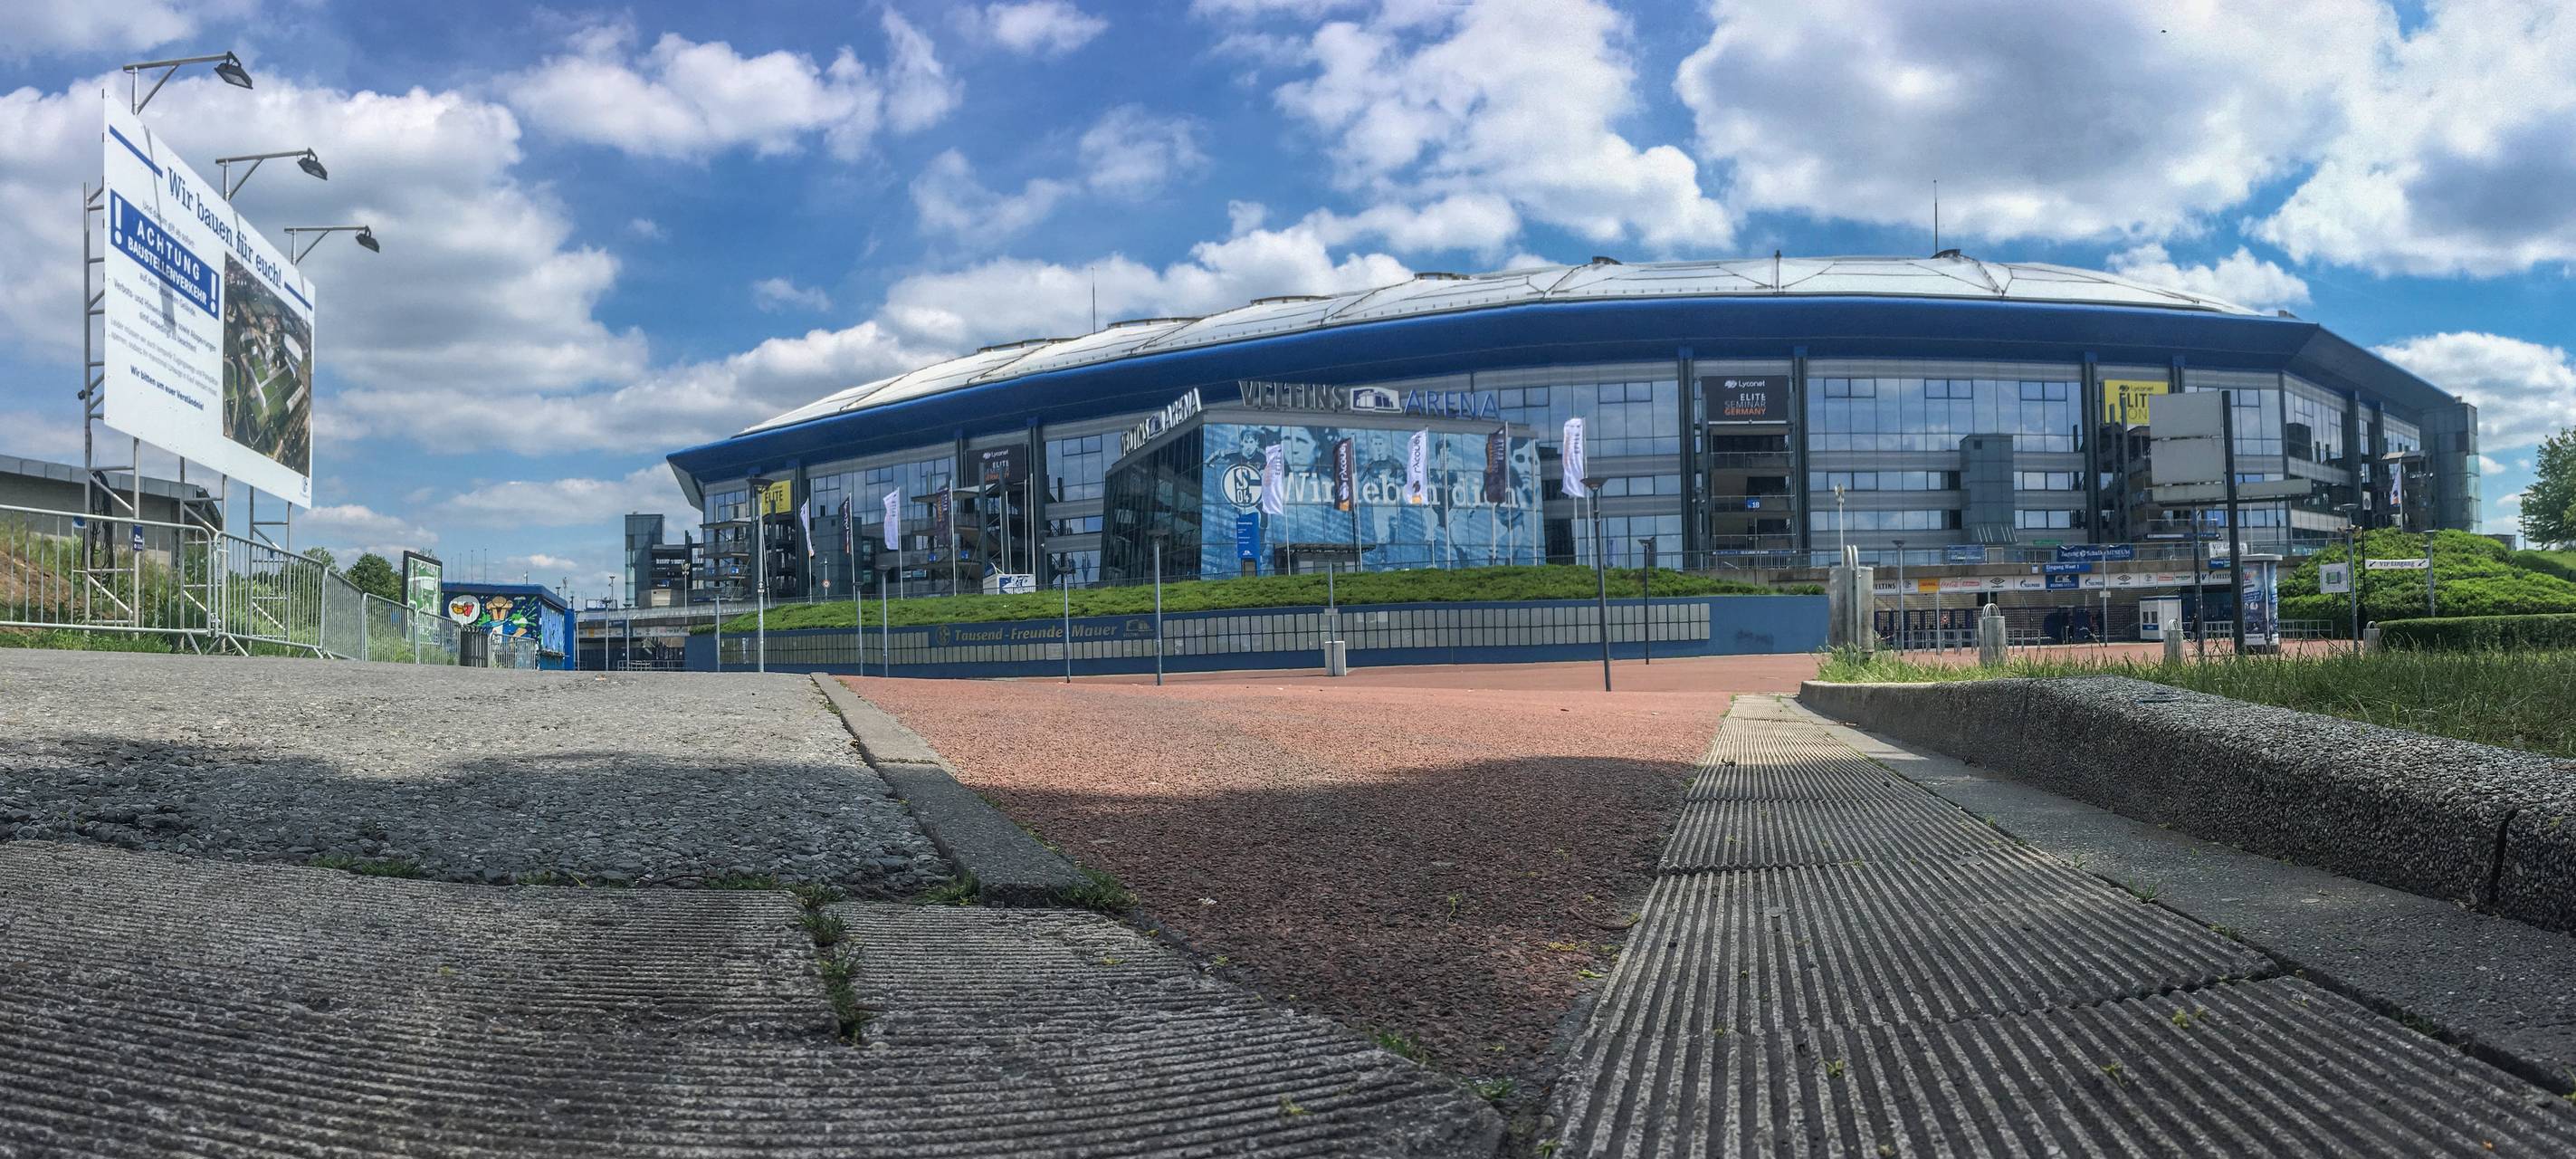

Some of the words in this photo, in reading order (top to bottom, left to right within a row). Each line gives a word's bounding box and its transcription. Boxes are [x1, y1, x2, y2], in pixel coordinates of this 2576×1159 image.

[167, 167, 193, 211] Wir
[196, 193, 233, 247] bauen
[236, 230, 253, 263] für
[255, 254, 281, 290] euch!
[138, 219, 199, 280] ACHTUNG
[128, 235, 207, 305] BAUSTELLENVERKEHR
[130, 364, 139, 378] Wir
[140, 369, 155, 387] bitten
[157, 379, 164, 390] um
[177, 388, 204, 412] Verständnis!
[1738, 380, 1765, 388] Lyconet
[1238, 380, 1346, 411] VELTINS
[1403, 389, 1500, 420] ARENA
[1740, 392, 1766, 401] ELITE
[2120, 393, 2149, 407] LIT
[1165, 387, 1202, 434] ARENA
[1724, 400, 1766, 408] SEMINAR
[1724, 407, 1766, 416] GERMANY
[2128, 407, 2148, 419] ON
[1352, 469, 1440, 505] lebn
[1452, 473, 1519, 507] di
[765, 490, 783, 503] ELITE
[1874, 582, 1896, 590] ELTINS
[1072, 624, 1117, 637] Mauer
